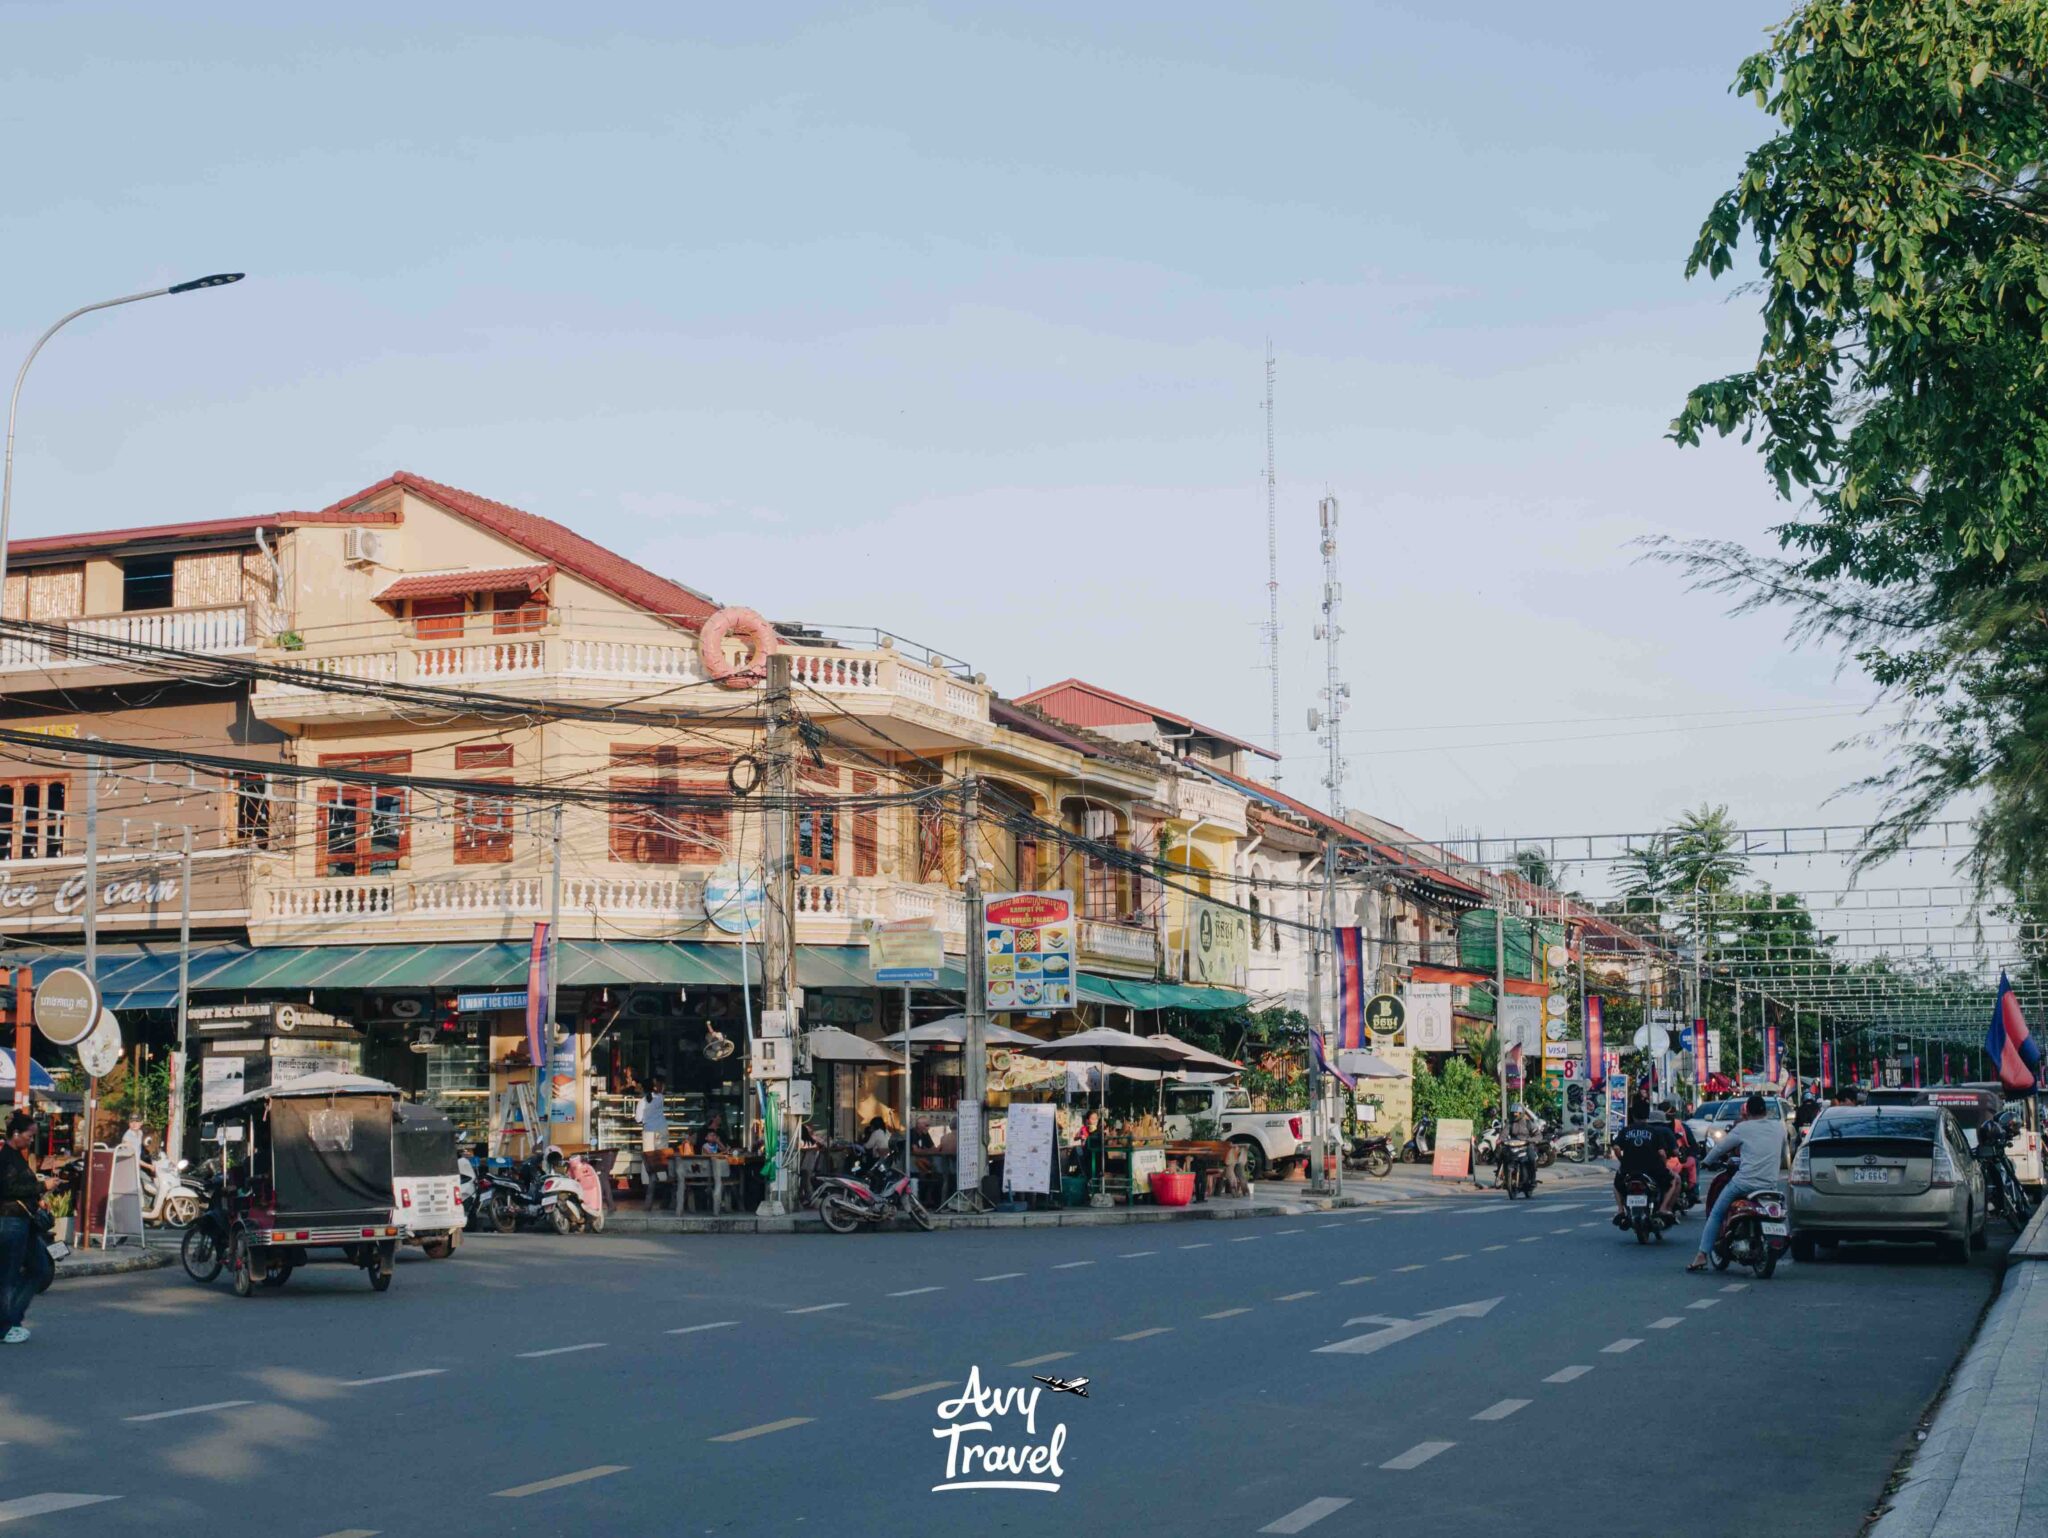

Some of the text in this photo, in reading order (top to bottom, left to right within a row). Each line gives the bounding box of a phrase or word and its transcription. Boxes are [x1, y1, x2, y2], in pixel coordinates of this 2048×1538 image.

[54, 871, 179, 913] Ceam
[460, 998, 464, 1010] I
[466, 997, 487, 1009] WANT
[489, 997, 501, 1008] ICE
[1548, 1046, 1566, 1054] VISA
